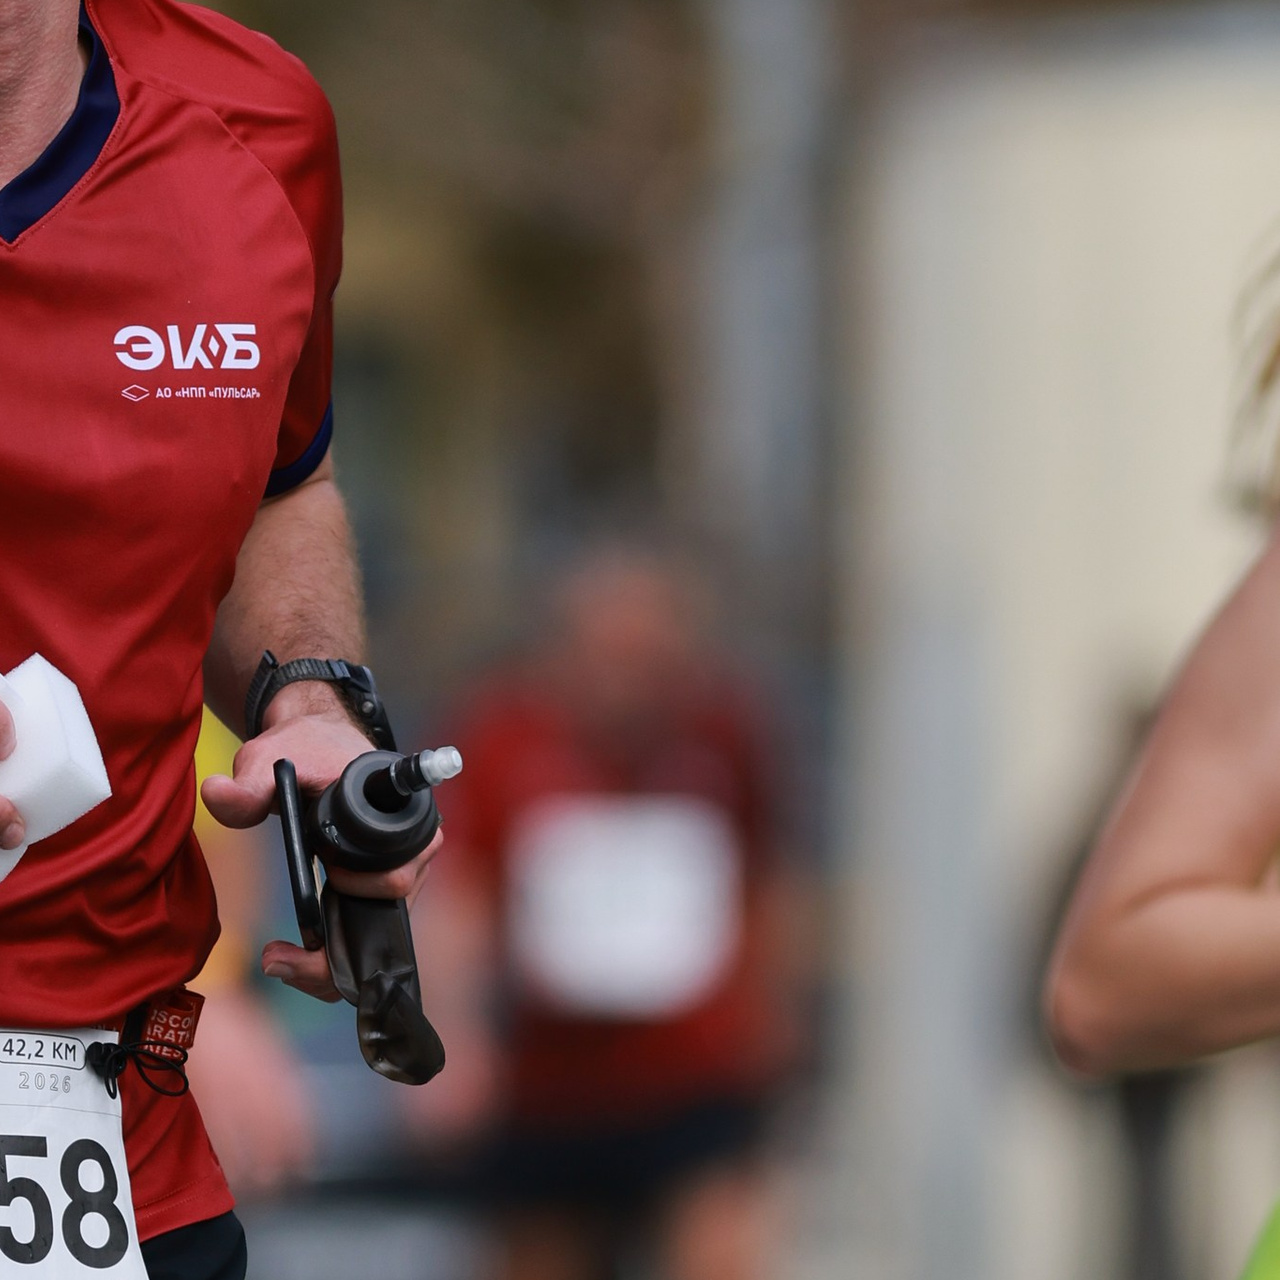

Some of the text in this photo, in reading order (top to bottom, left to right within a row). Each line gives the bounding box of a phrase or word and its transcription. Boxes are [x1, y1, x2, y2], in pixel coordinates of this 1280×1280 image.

[156, 387, 261, 400] АО «НПП «ПУЛЬСАР»
[2, 1038, 77, 1062] 42,2 КМ
[18, 1072, 71, 1093] 2026
